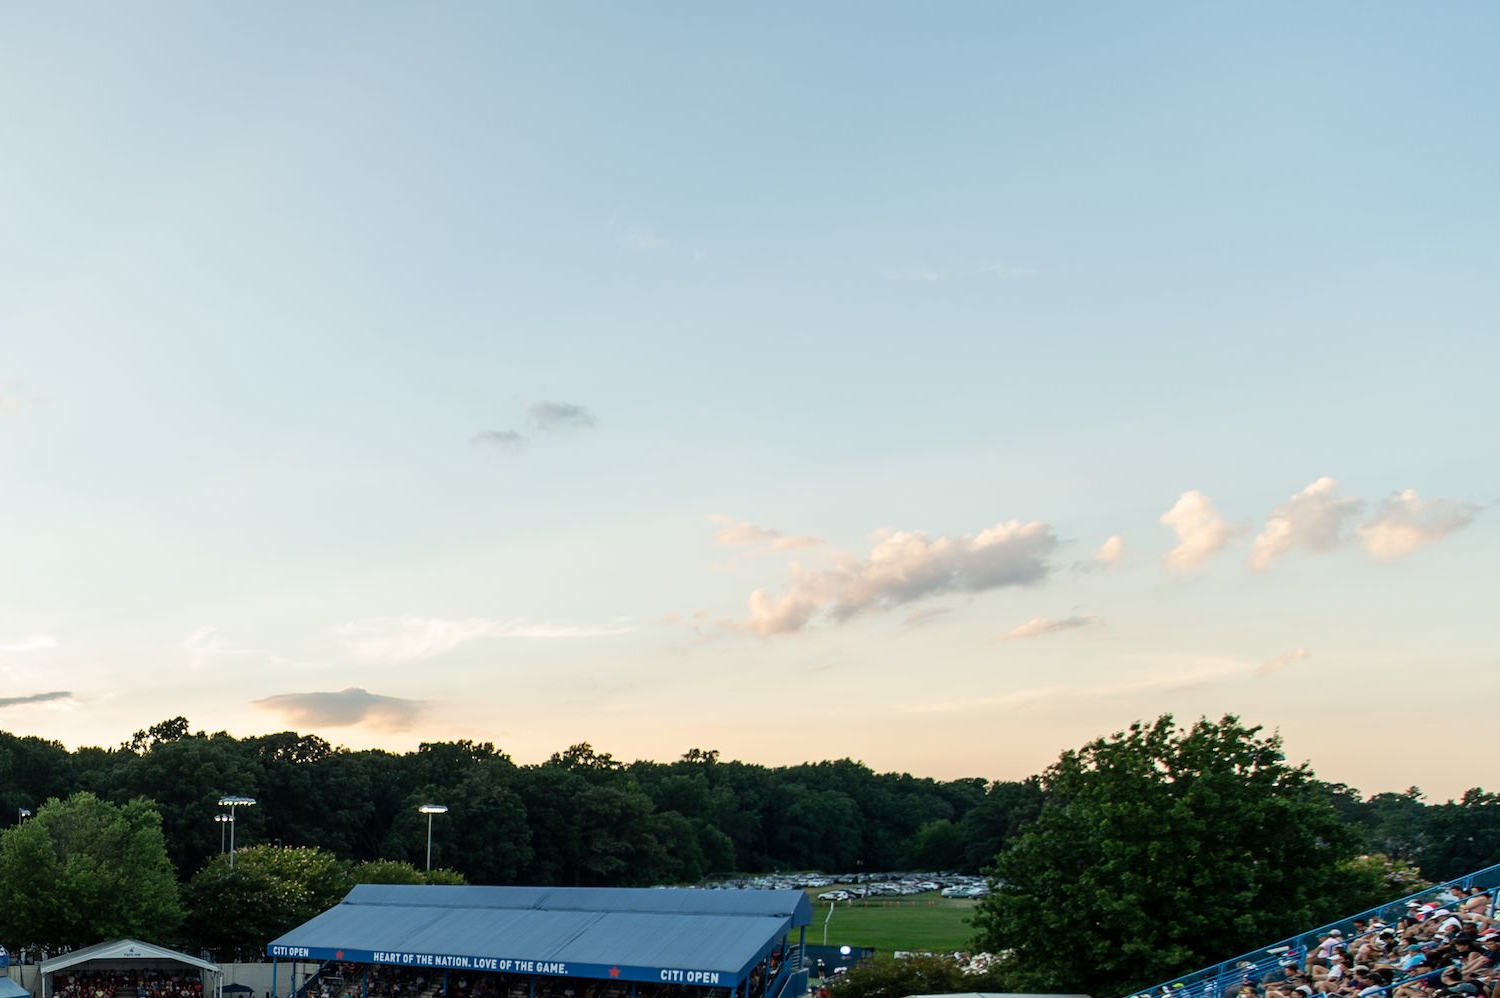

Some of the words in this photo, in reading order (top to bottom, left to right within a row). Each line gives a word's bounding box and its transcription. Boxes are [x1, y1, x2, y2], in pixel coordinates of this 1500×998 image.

[273, 946, 288, 956] CITI
[289, 947, 309, 957] OPEN
[373, 952, 401, 963] HEART
[403, 953, 414, 964] OF
[416, 954, 433, 965] THE
[435, 955, 471, 968] NATION.
[474, 958, 498, 970] LOVE
[499, 959, 512, 970] OF
[514, 960, 534, 972] THE
[536, 962, 568, 974] GAME.
[660, 969, 683, 982] CITI
[687, 971, 719, 984] OPEN
